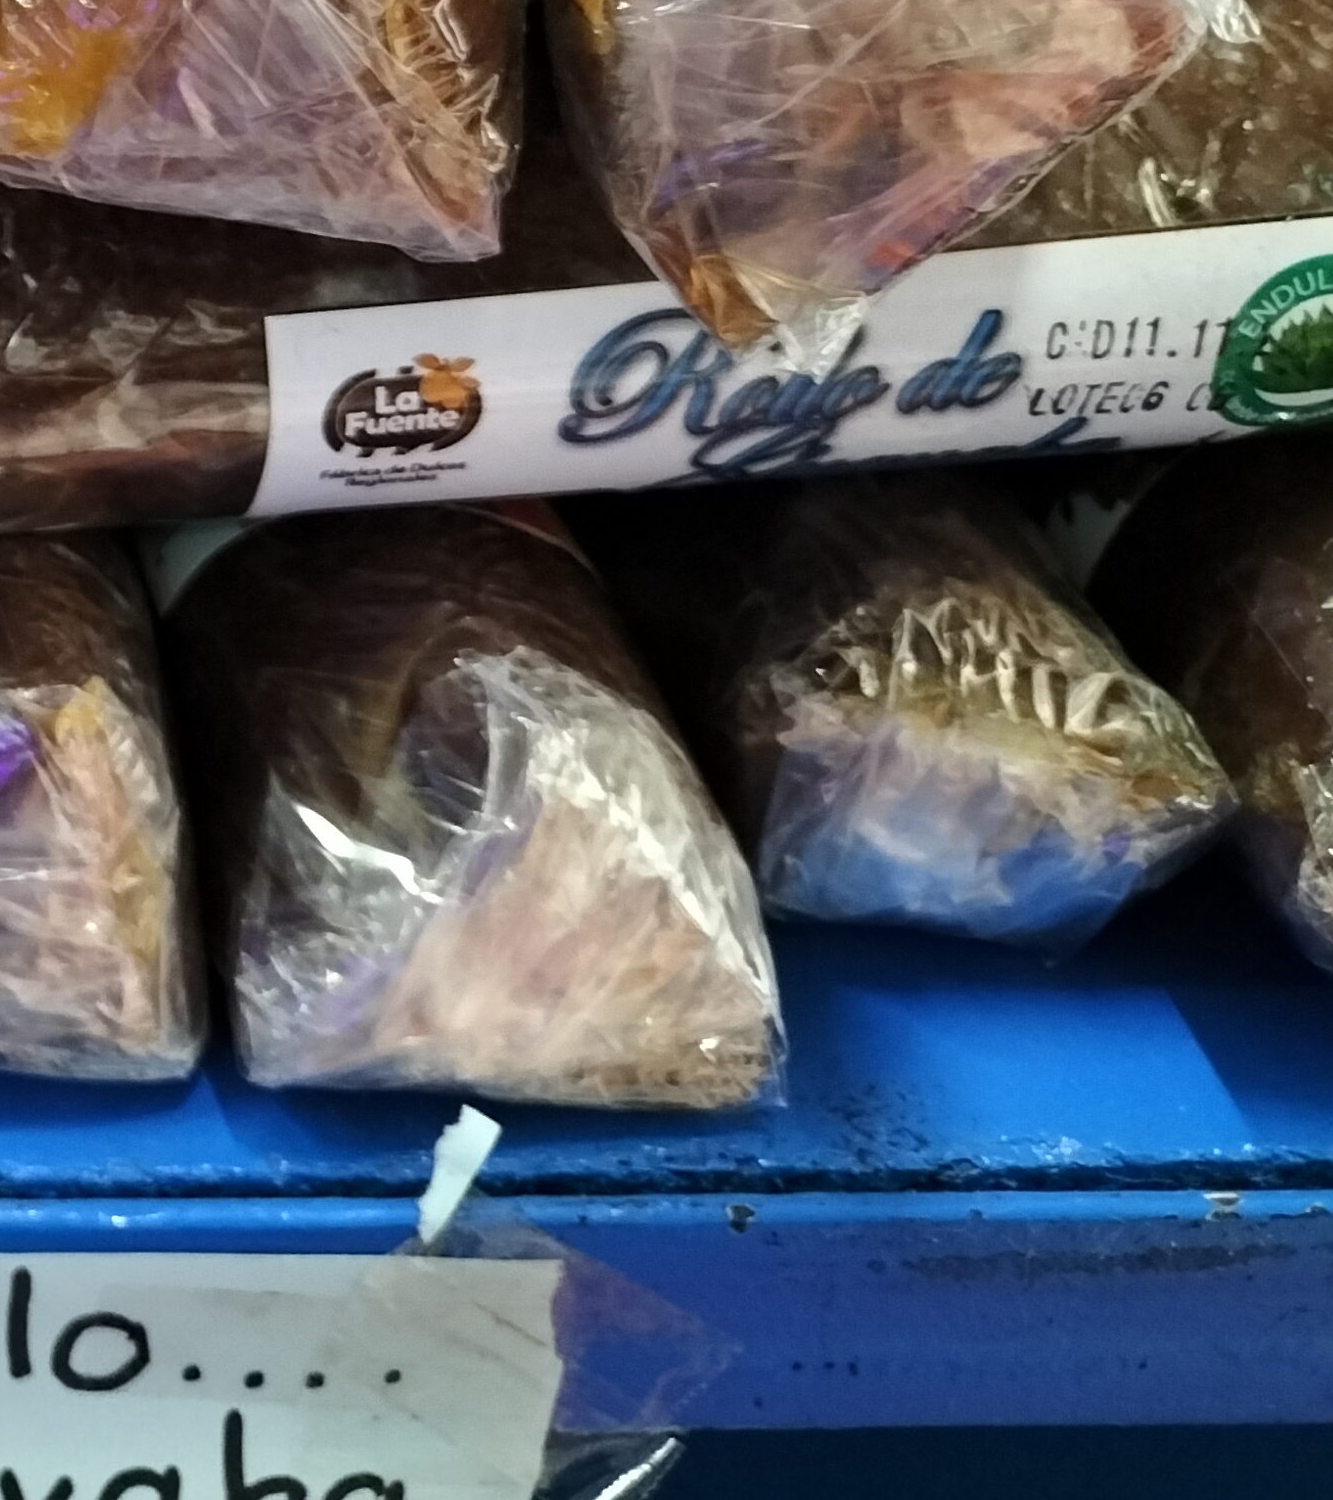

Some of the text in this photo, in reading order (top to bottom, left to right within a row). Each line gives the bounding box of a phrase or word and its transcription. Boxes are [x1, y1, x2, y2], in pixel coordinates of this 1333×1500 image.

[896, 309, 1024, 417] de
[375, 385, 420, 414] La
[344, 407, 461, 437] Fuente
